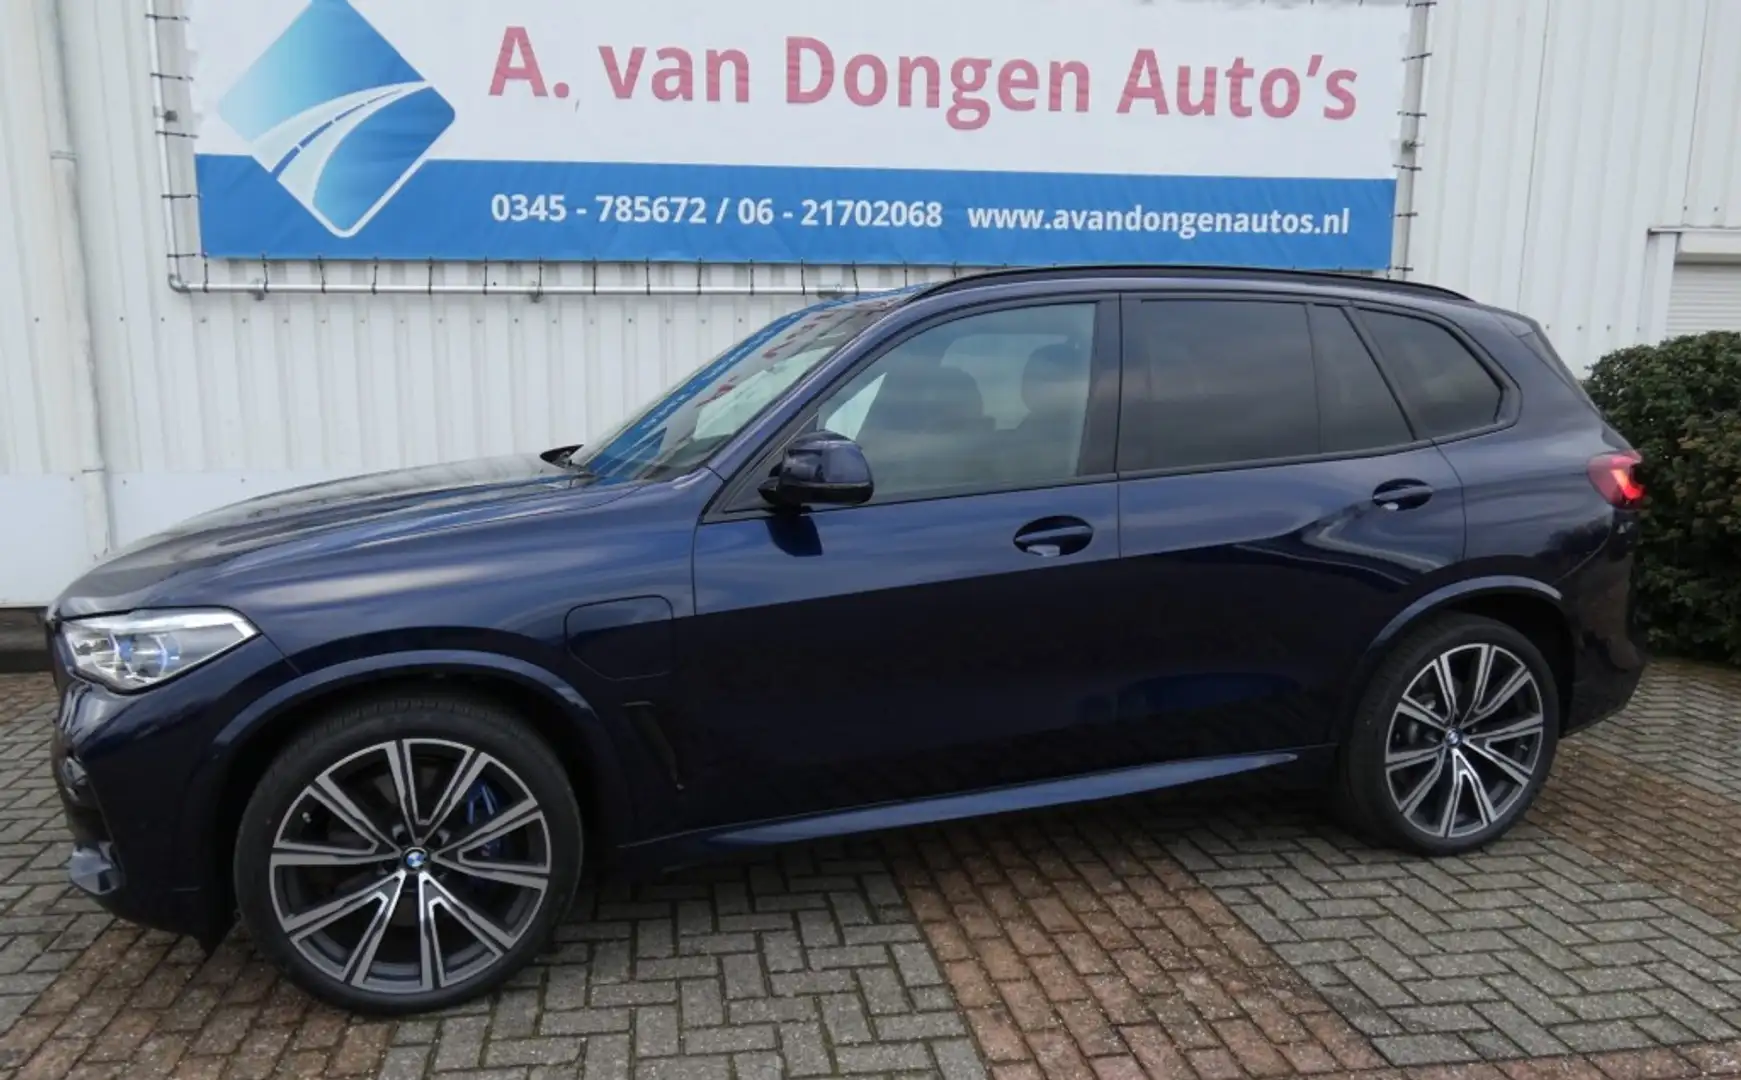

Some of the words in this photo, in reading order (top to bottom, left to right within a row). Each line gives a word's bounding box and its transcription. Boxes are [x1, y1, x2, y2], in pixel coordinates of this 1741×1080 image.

[489, 26, 569, 97] A.
[598, 46, 750, 103] van
[785, 36, 1090, 130] Dongen
[1117, 48, 1358, 120] Auto’s
[490, 194, 567, 222] 0345
[595, 195, 707, 224] 785672
[738, 197, 774, 226] 06
[801, 199, 943, 228] 21702068
[967, 205, 1350, 241] www.avandongenautos.nl
